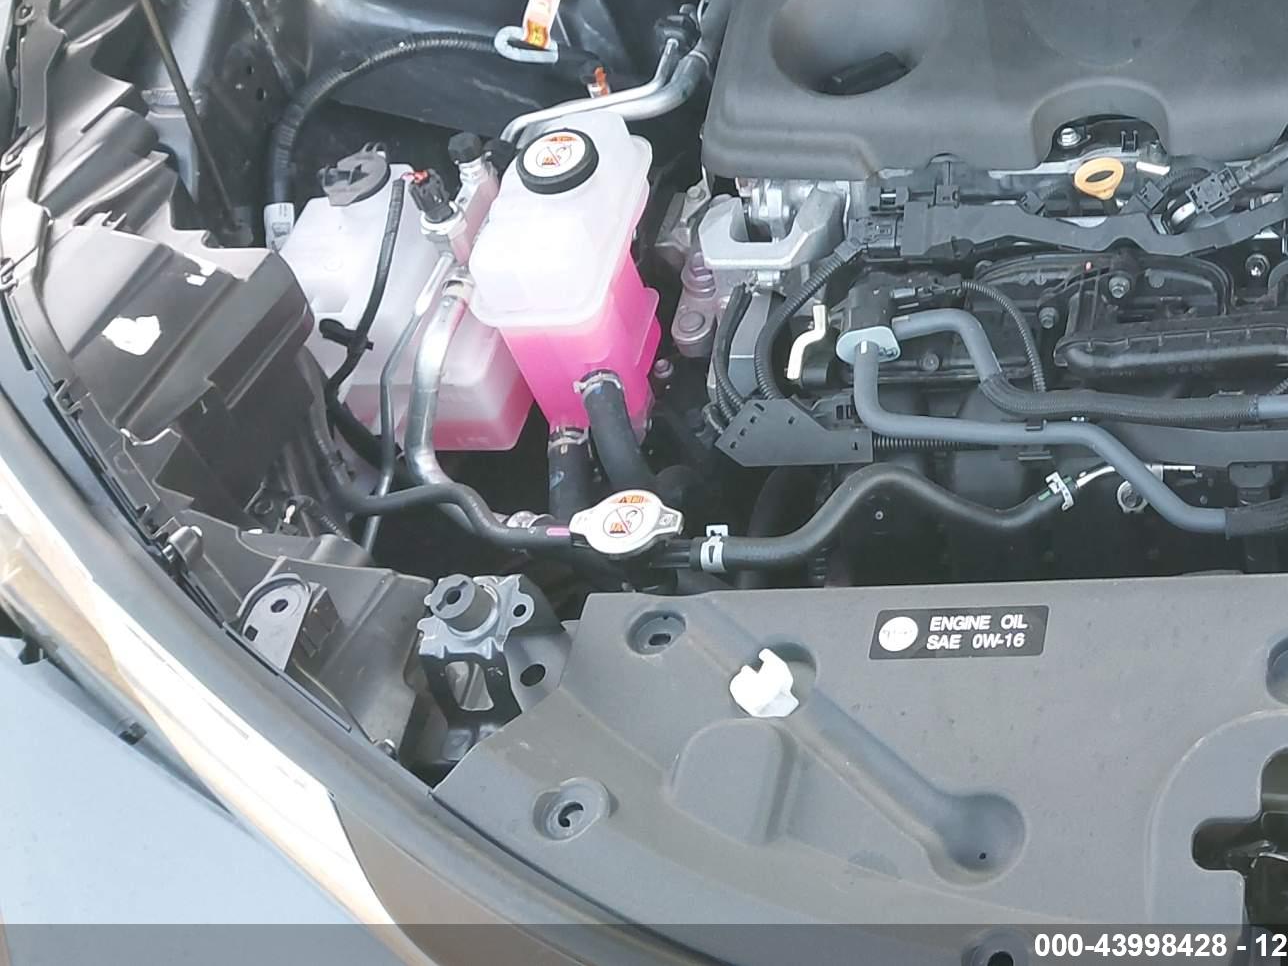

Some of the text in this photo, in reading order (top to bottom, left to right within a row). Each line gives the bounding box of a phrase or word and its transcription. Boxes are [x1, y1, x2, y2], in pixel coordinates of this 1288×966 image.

[929, 613, 1028, 631] ENGINE OIL
[926, 632, 1025, 650] SAE 0W-16
